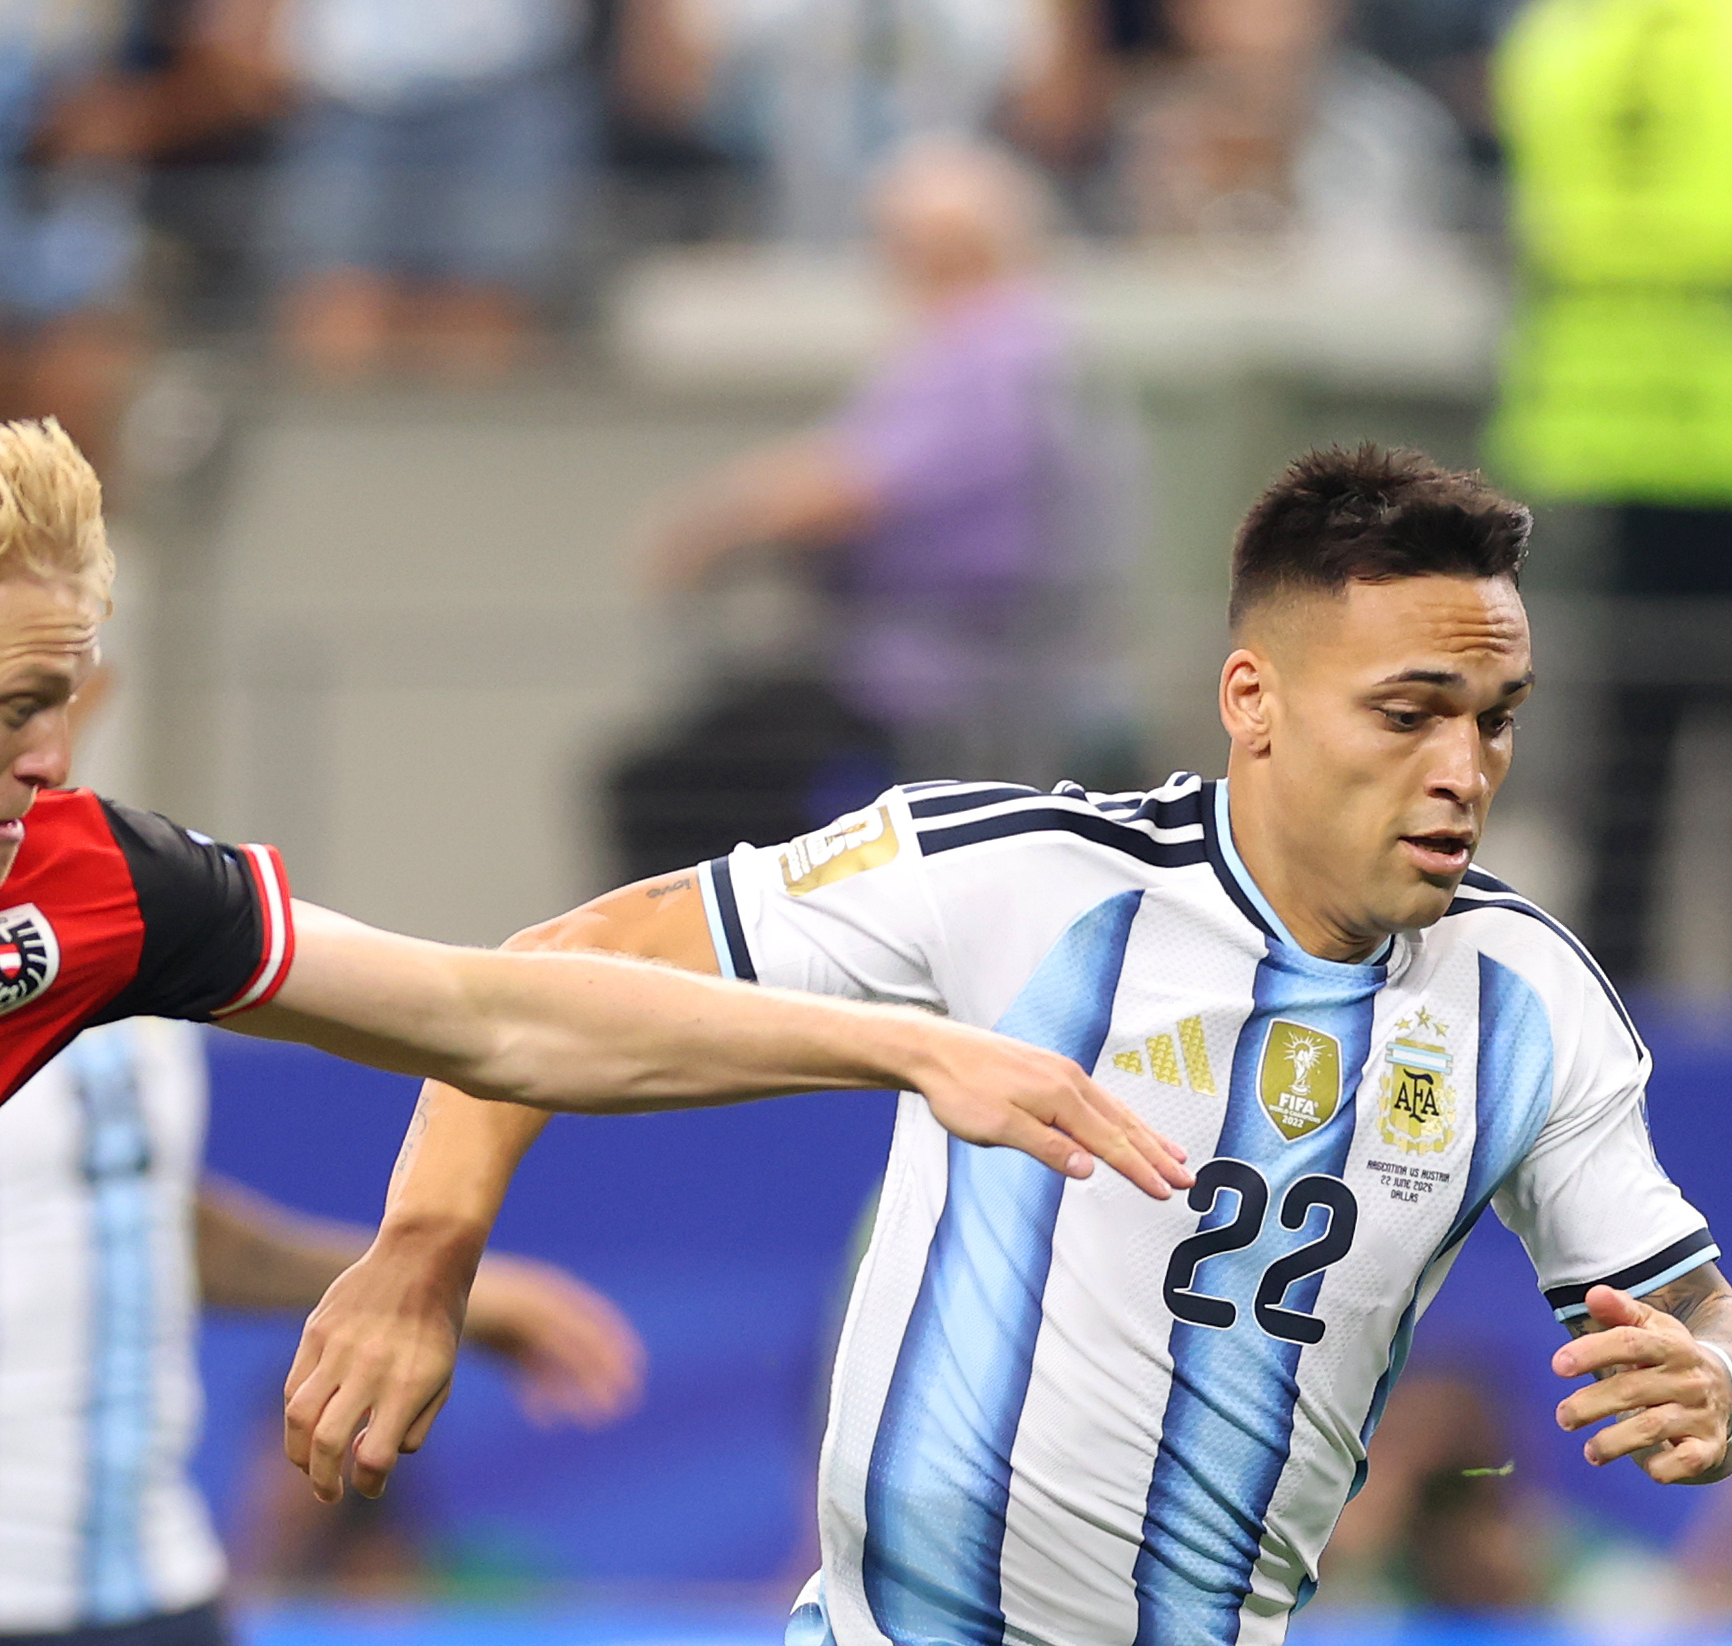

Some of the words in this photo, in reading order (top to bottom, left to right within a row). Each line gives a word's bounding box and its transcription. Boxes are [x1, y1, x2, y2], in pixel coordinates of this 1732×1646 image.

[1394, 1067, 1439, 1123] AFA
[1282, 1114, 1305, 1128] 2022
[1380, 1175, 1392, 1186] 22
[1393, 1177, 1412, 1189] JUNE
[1413, 1181, 1434, 1193] 2026
[1390, 1189, 1419, 1203] DALLAS
[1163, 1157, 1358, 1345] 22
